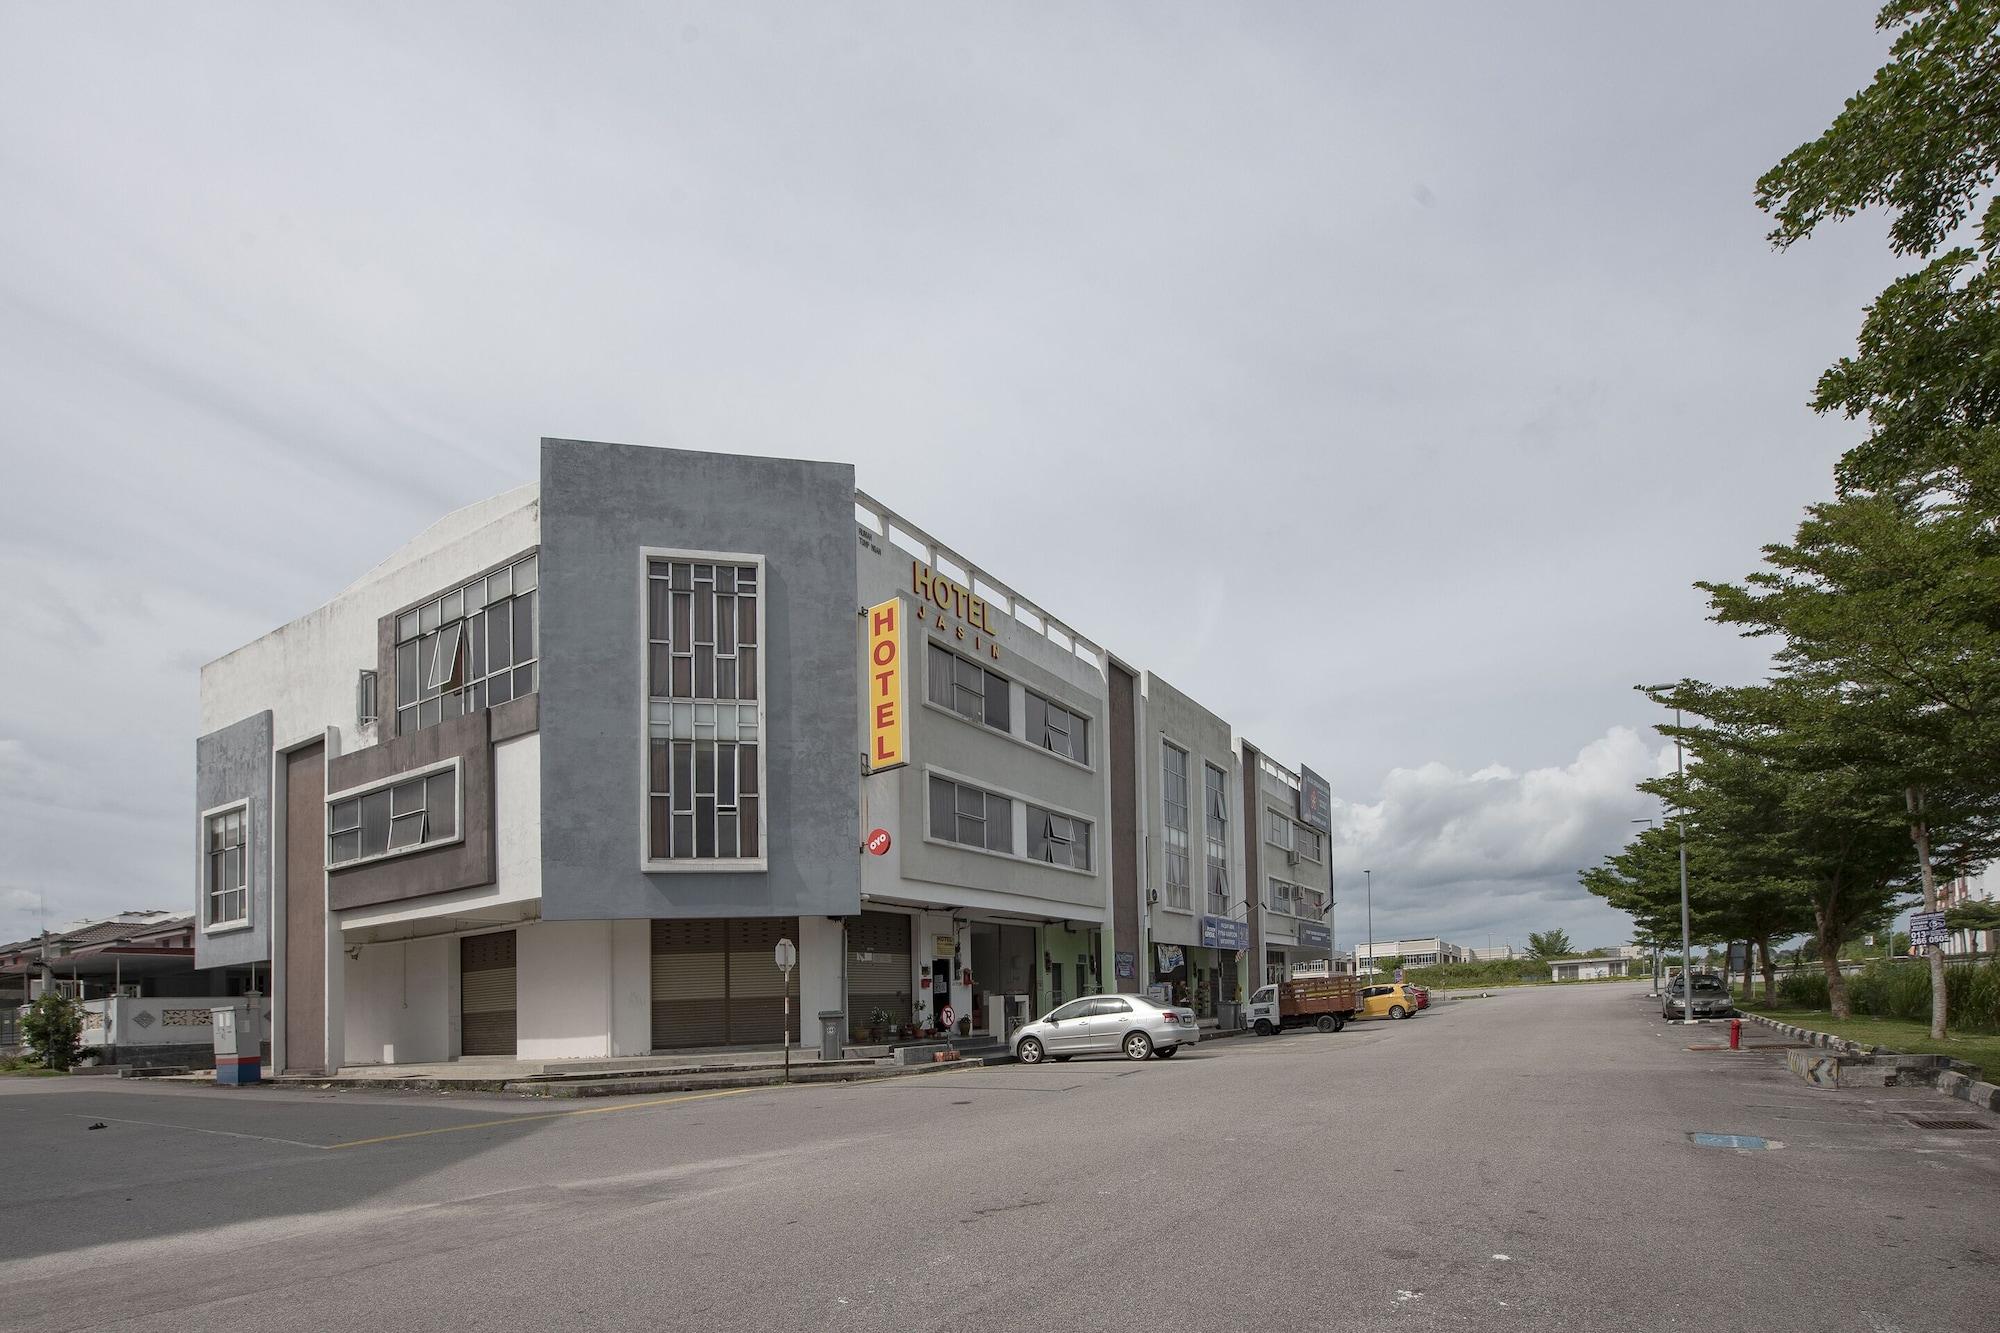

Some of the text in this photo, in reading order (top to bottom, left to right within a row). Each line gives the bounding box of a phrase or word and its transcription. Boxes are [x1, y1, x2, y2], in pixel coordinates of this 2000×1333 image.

[913, 560, 996, 636] HOTEL
[917, 605, 999, 660] JASIN
[873, 607, 896, 760] HOTEL
[1911, 931, 1926, 939] 013
